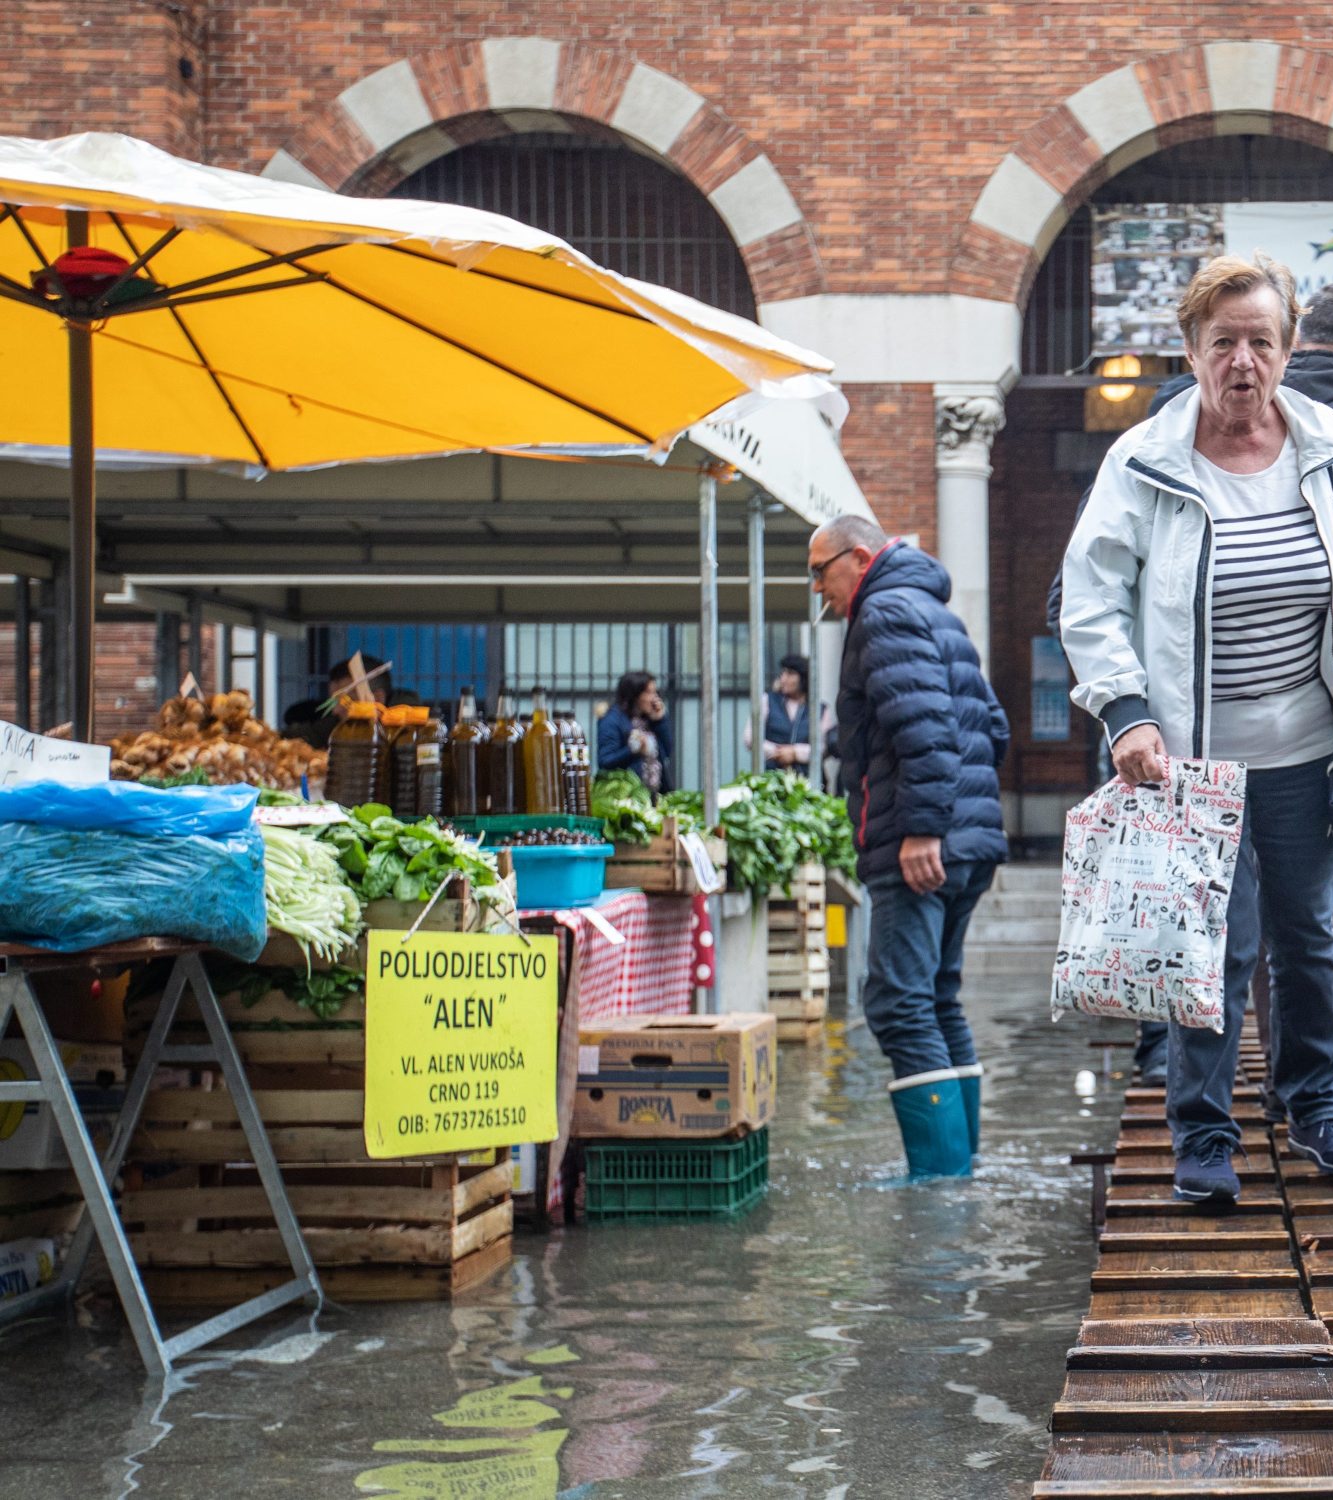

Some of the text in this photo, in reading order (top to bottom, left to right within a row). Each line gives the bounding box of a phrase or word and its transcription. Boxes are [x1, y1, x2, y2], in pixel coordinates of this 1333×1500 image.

[1143, 812, 1184, 836] Sales
[380, 950, 547, 979] POLJODJELSTVO
[1096, 993, 1122, 1008] Sales
[658, 1038, 685, 1050] PACK
[401, 1047, 525, 1076] VL. ALEN VUKOŠA
[429, 1080, 500, 1104] CRNO 119
[398, 1106, 527, 1135] OIB: 76737261510
[619, 1095, 676, 1123] BONITA
